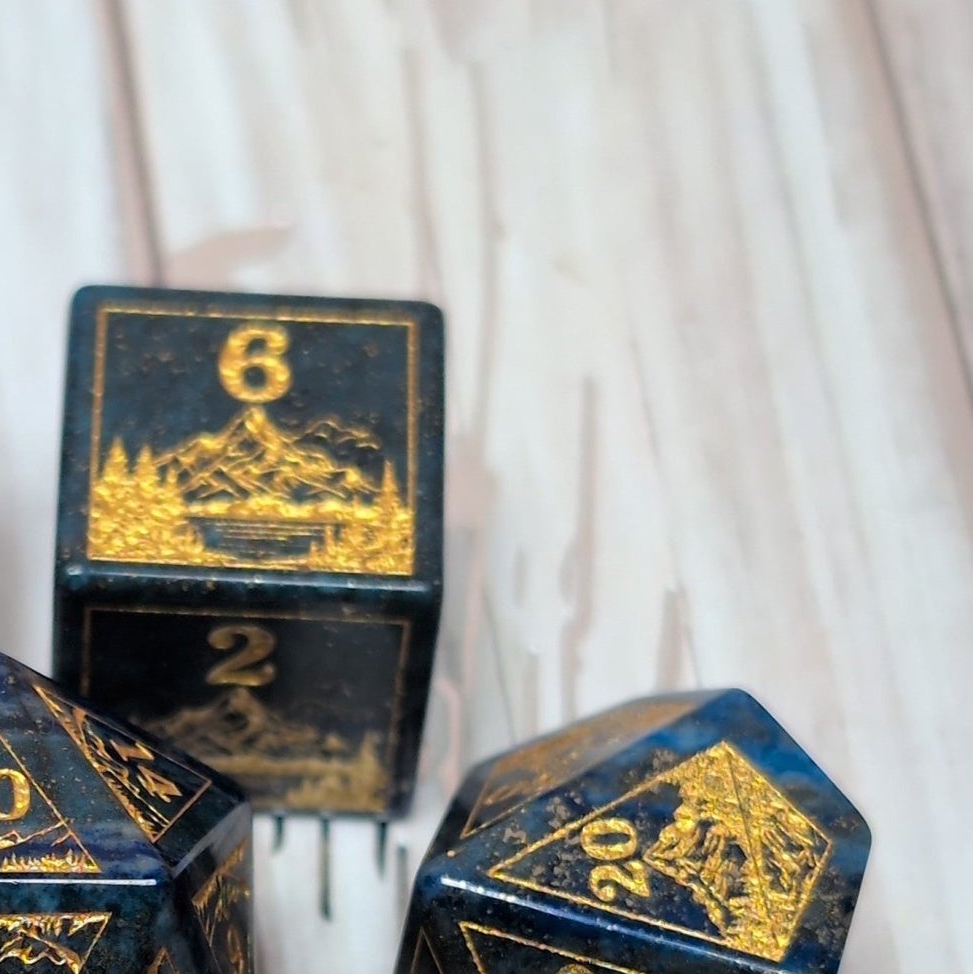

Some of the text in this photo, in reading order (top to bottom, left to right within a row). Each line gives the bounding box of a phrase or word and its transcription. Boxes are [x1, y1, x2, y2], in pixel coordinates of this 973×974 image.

[218, 322, 293, 403] 6
[206, 624, 277, 687] 2
[111, 738, 183, 804] 14
[581, 816, 651, 903] 20
